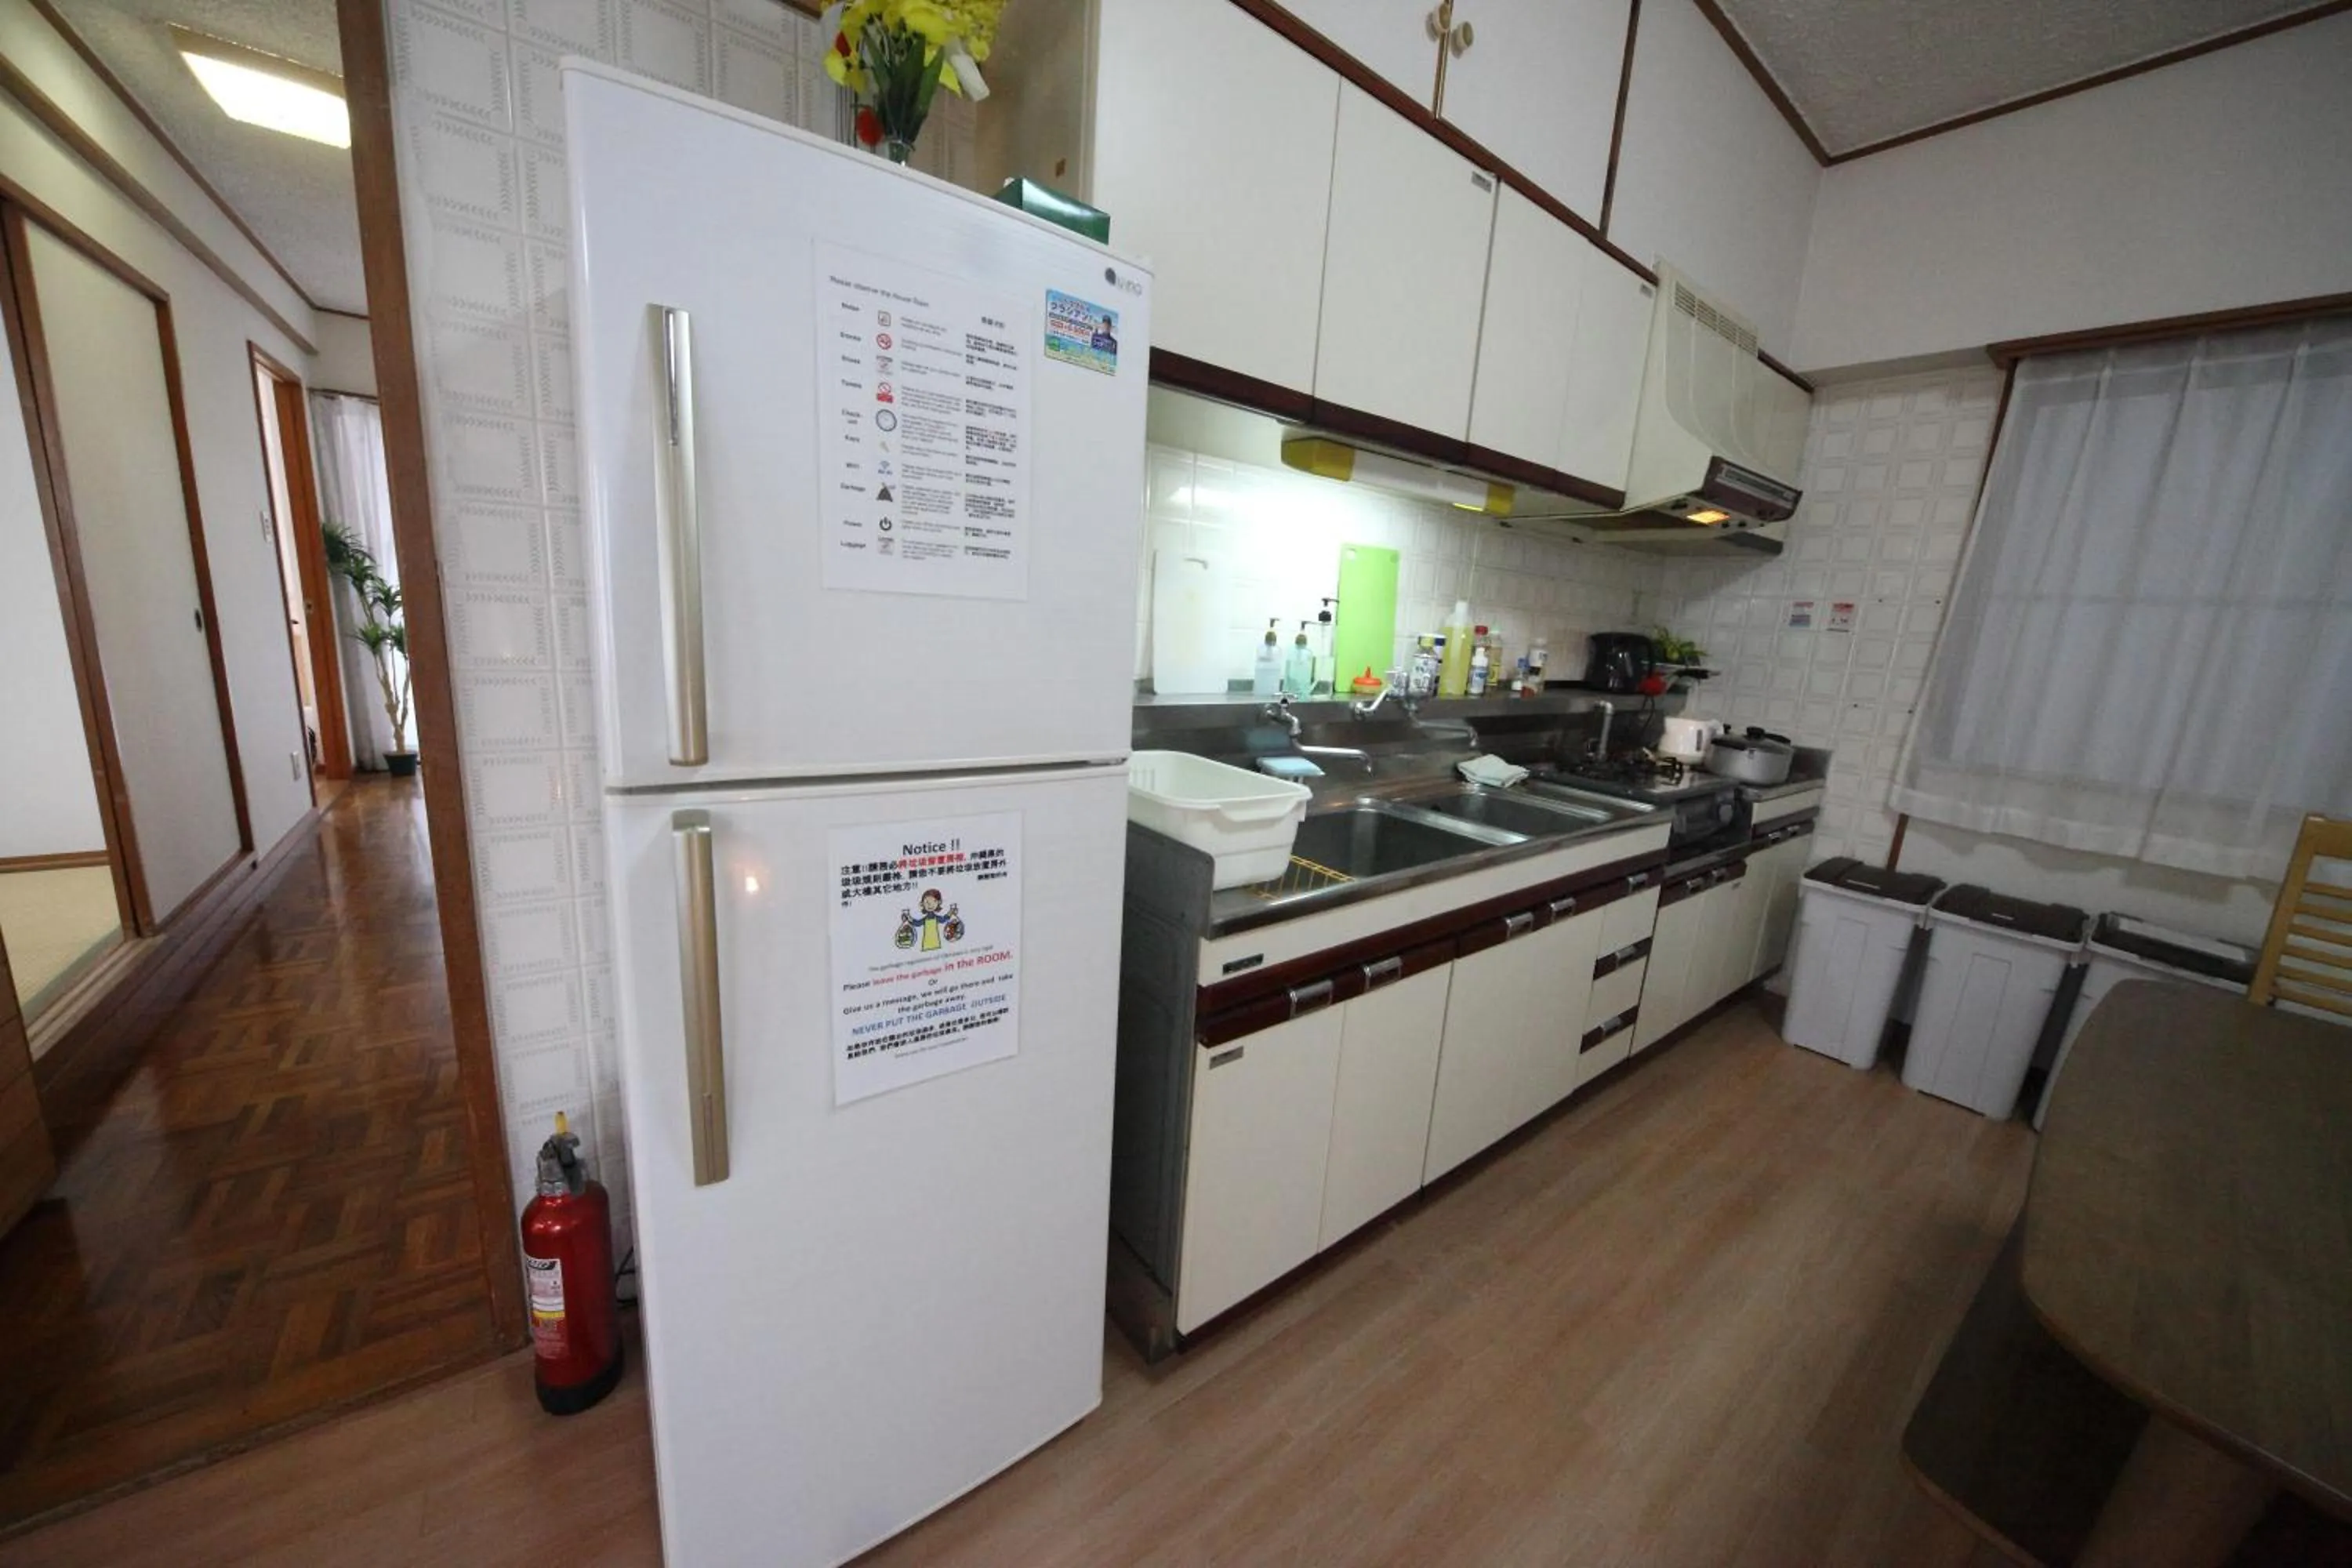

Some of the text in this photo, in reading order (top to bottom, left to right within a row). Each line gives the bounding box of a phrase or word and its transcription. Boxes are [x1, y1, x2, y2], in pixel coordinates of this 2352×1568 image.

[902, 838, 960, 856] Notice !!
[843, 980, 871, 991] Please
[911, 967, 942, 980] garbage
[945, 962, 954, 971] in
[957, 959, 974, 969] the
[927, 978, 938, 986] Or
[843, 1005, 862, 1014] Give
[982, 976, 995, 985] and
[913, 1000, 942, 1011] garbage
[852, 993, 1005, 1035] NEVER PUT THE GARBAGE OUTSIDE
